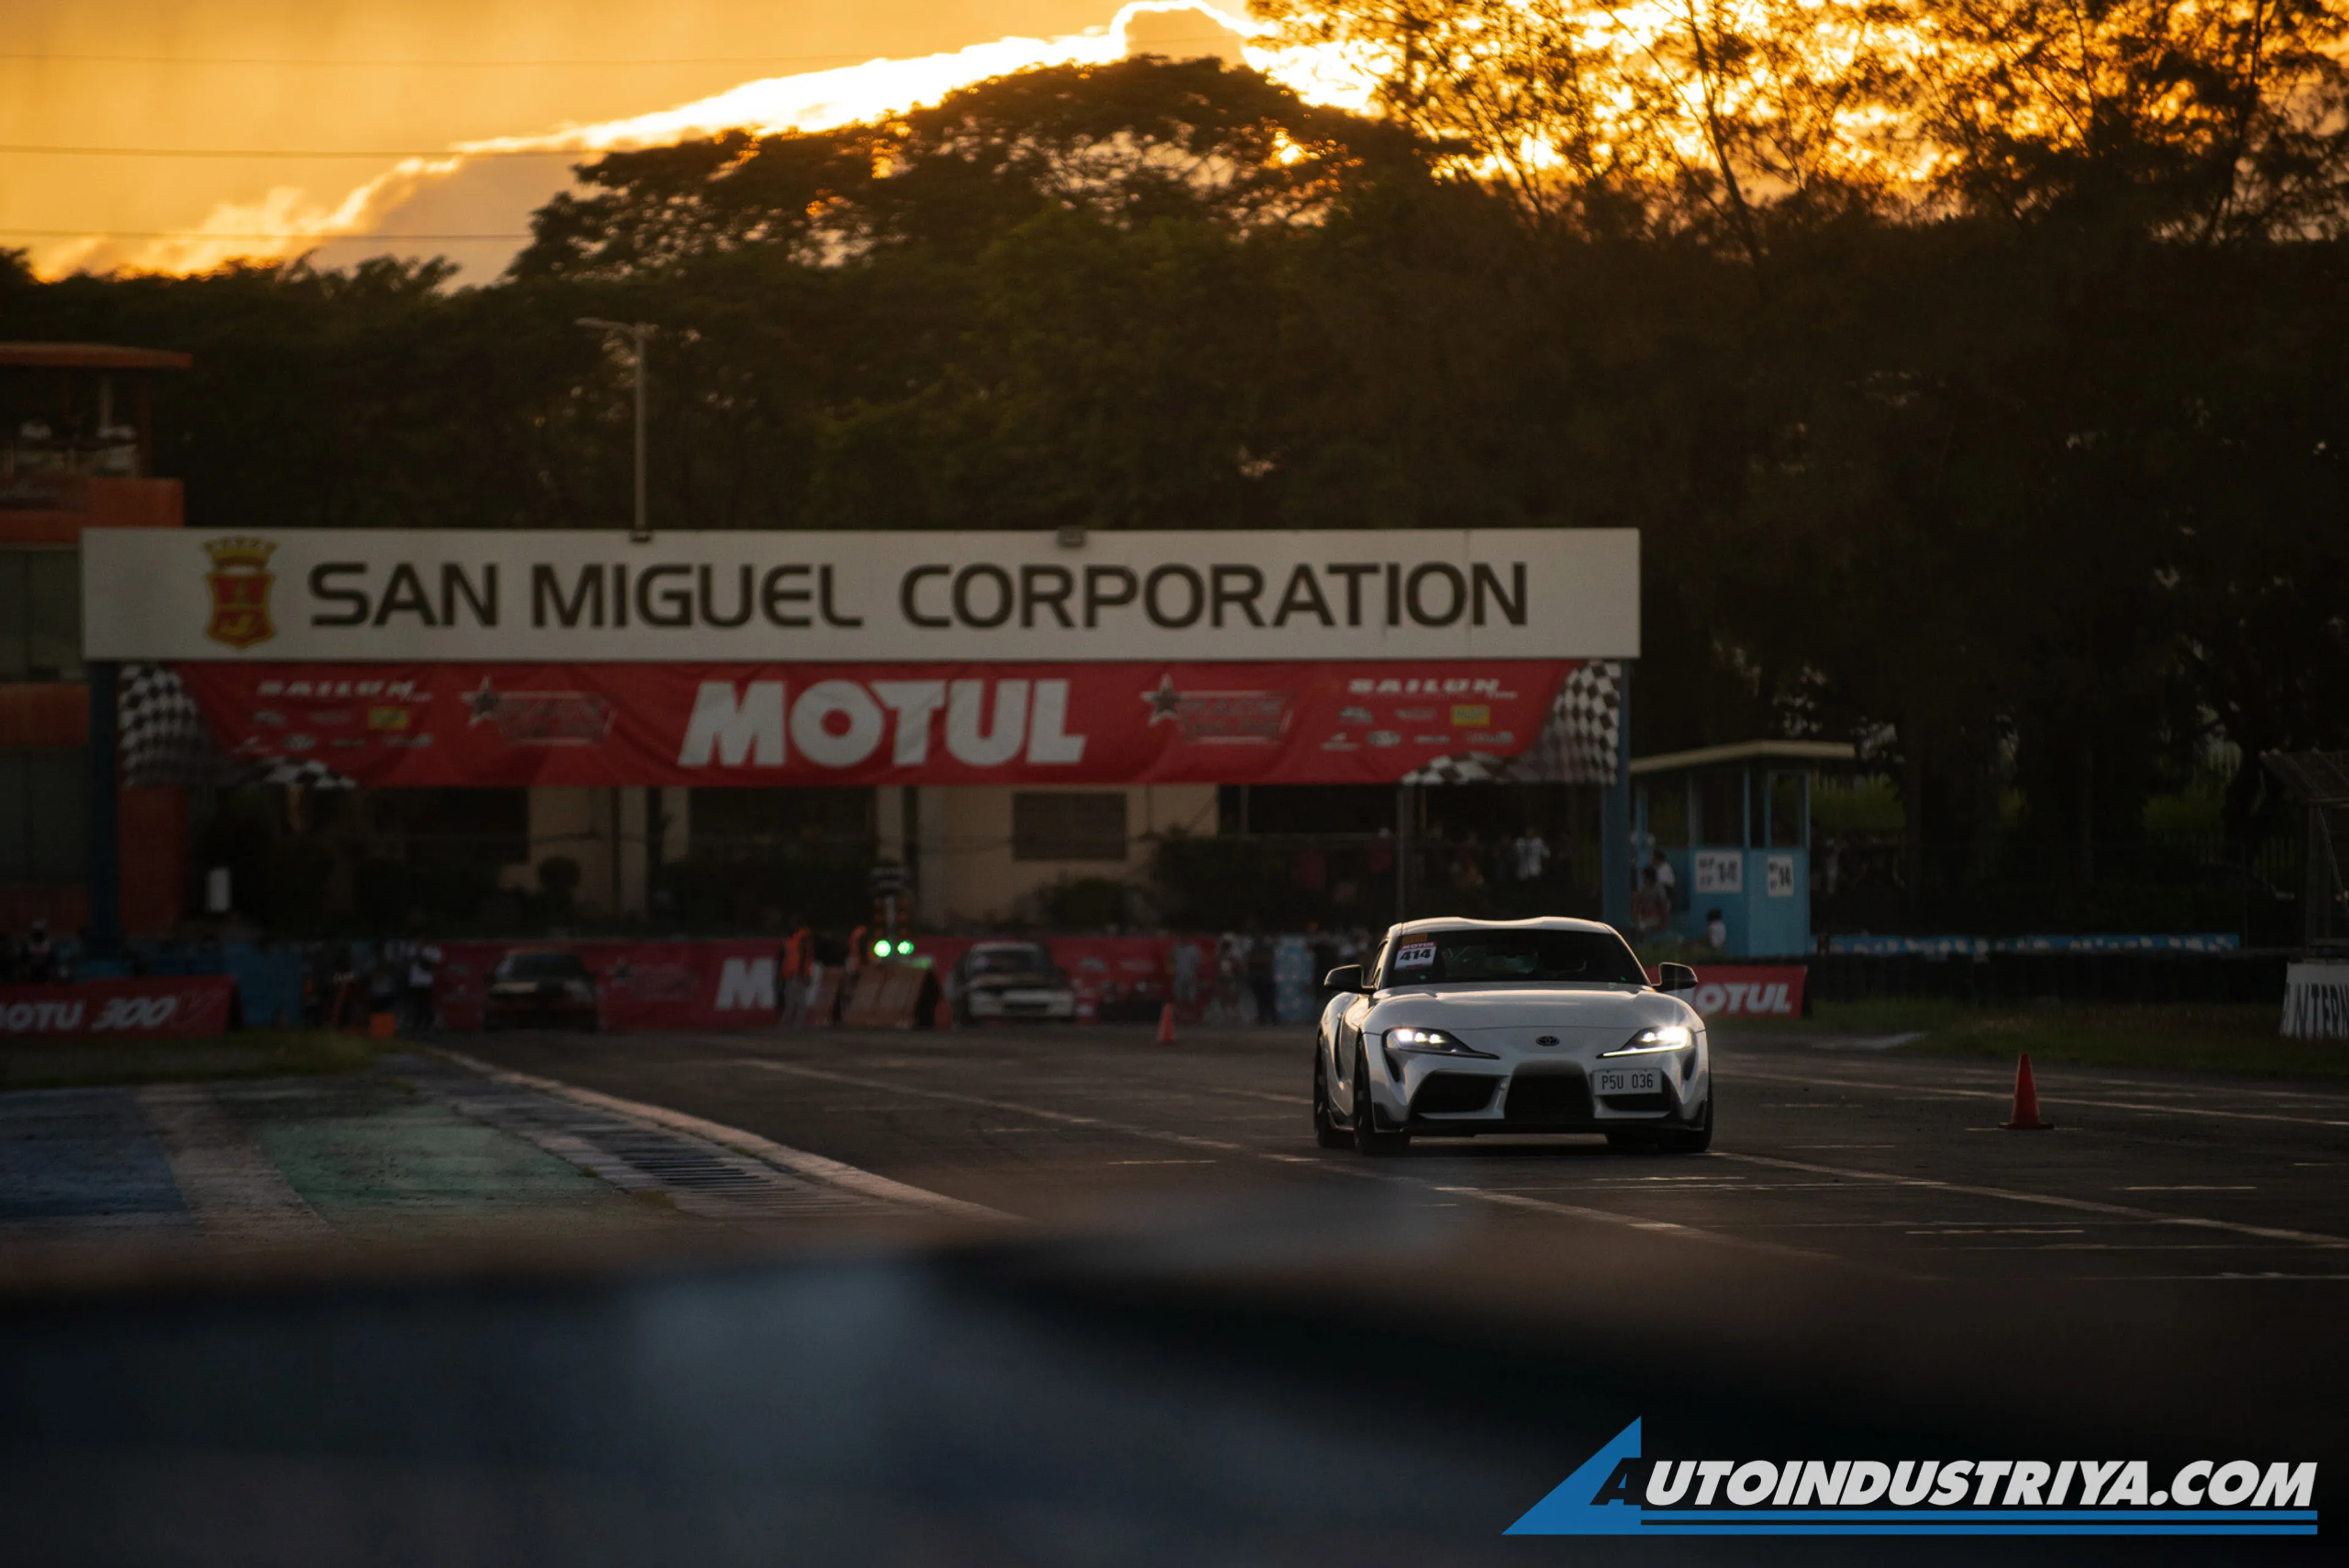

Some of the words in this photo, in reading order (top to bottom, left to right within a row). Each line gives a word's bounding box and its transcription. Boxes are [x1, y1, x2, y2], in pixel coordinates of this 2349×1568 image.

[308, 563, 499, 627] SAN
[531, 563, 864, 628] MIGUEL
[899, 562, 1528, 628] CORPORATION
[677, 678, 1087, 766] MOTUL
[1400, 948, 1431, 961] 414
[1601, 1075, 1624, 1090] P5U
[1631, 1073, 1653, 1089] 036
